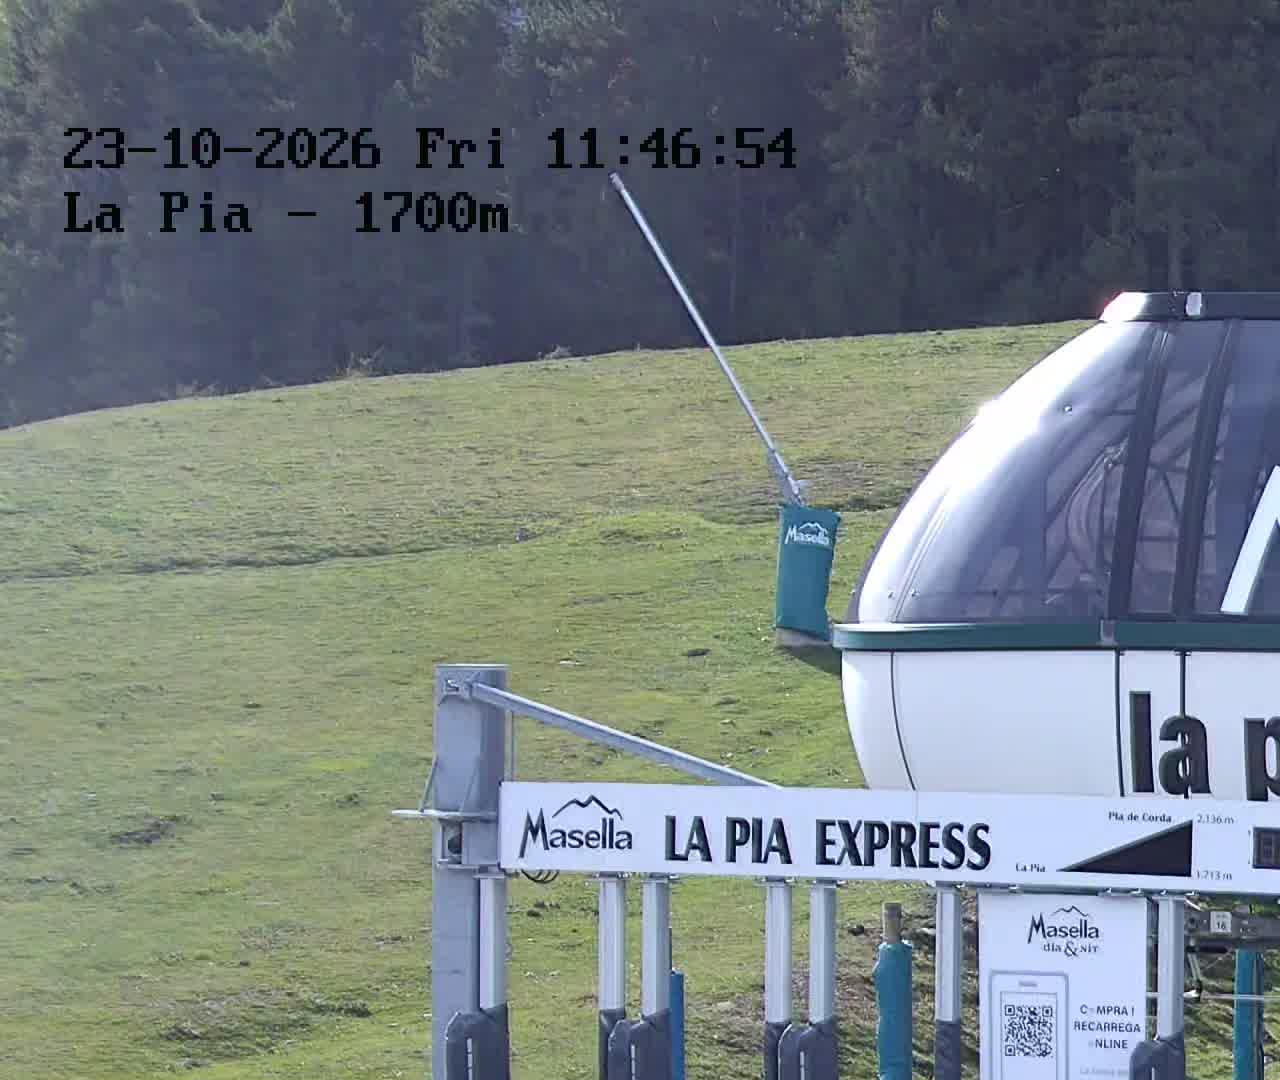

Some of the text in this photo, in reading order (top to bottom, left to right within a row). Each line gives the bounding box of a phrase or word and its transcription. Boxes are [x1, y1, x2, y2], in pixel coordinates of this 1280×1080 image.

[1129, 690, 1211, 796] la
[1128, 812, 1139, 822] de
[518, 807, 633, 859] Masella
[664, 815, 992, 871] LA PIA EXPRESS
[1027, 912, 1099, 944] Masella
[1063, 940, 1079, 957] &
[1080, 1004, 1128, 1016] CMPRA
[1074, 1021, 1141, 1033] RECARREGA
[1088, 1039, 1128, 1049] NLINE
